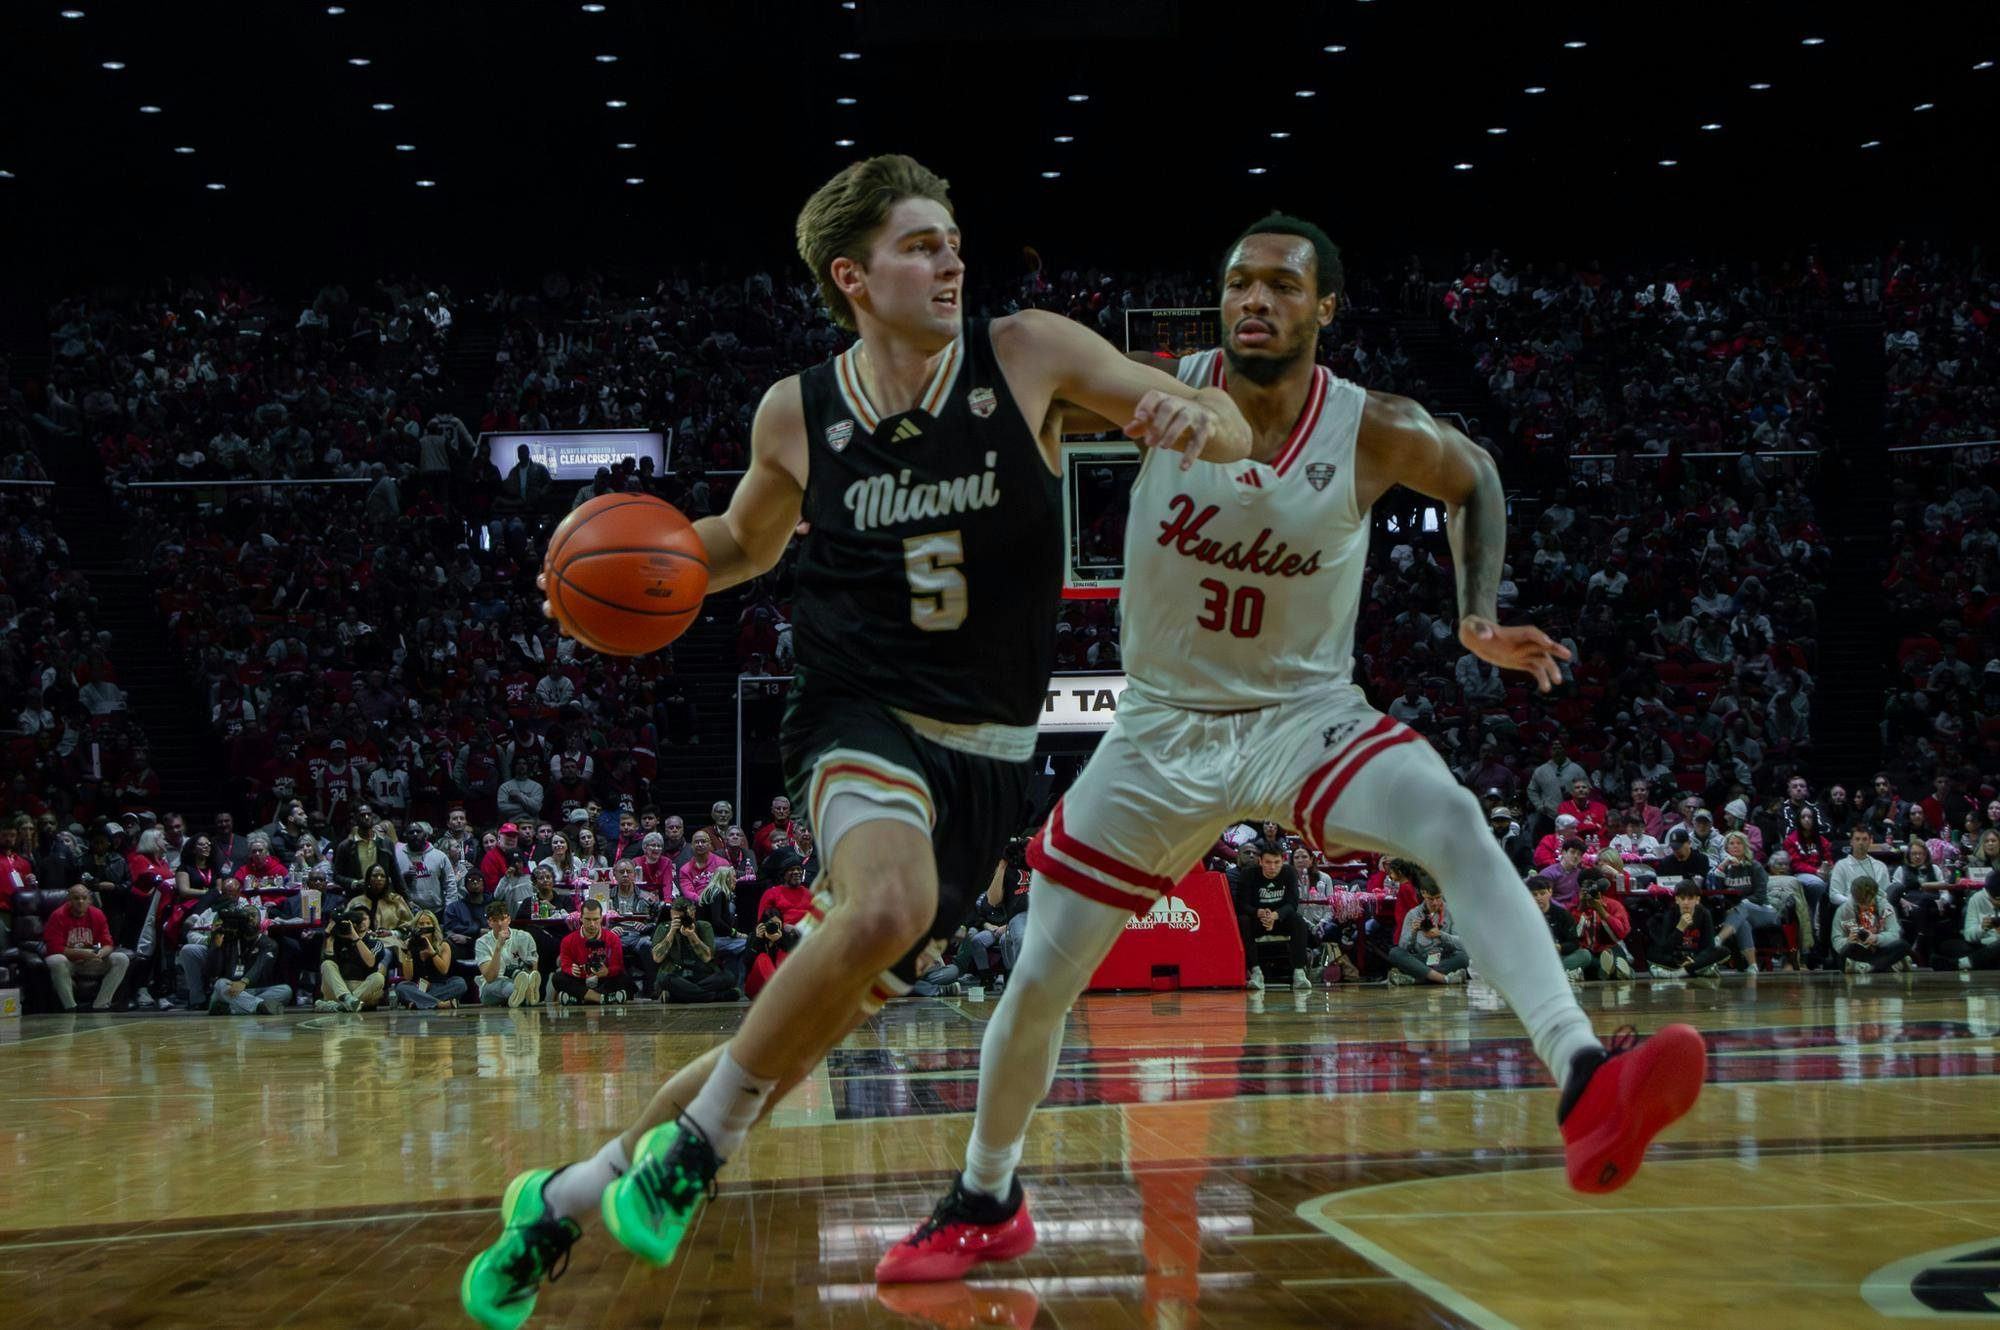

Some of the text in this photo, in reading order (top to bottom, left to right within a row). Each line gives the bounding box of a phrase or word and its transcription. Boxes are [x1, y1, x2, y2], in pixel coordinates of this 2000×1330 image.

[560, 453, 586, 465] CLEAN
[843, 450, 1001, 532] Miami
[1157, 493, 1322, 577] Huskies
[901, 529, 970, 632] 5
[1197, 577, 1265, 638] 30
[765, 683, 780, 695] 13
[1258, 885, 1286, 898] Miami
